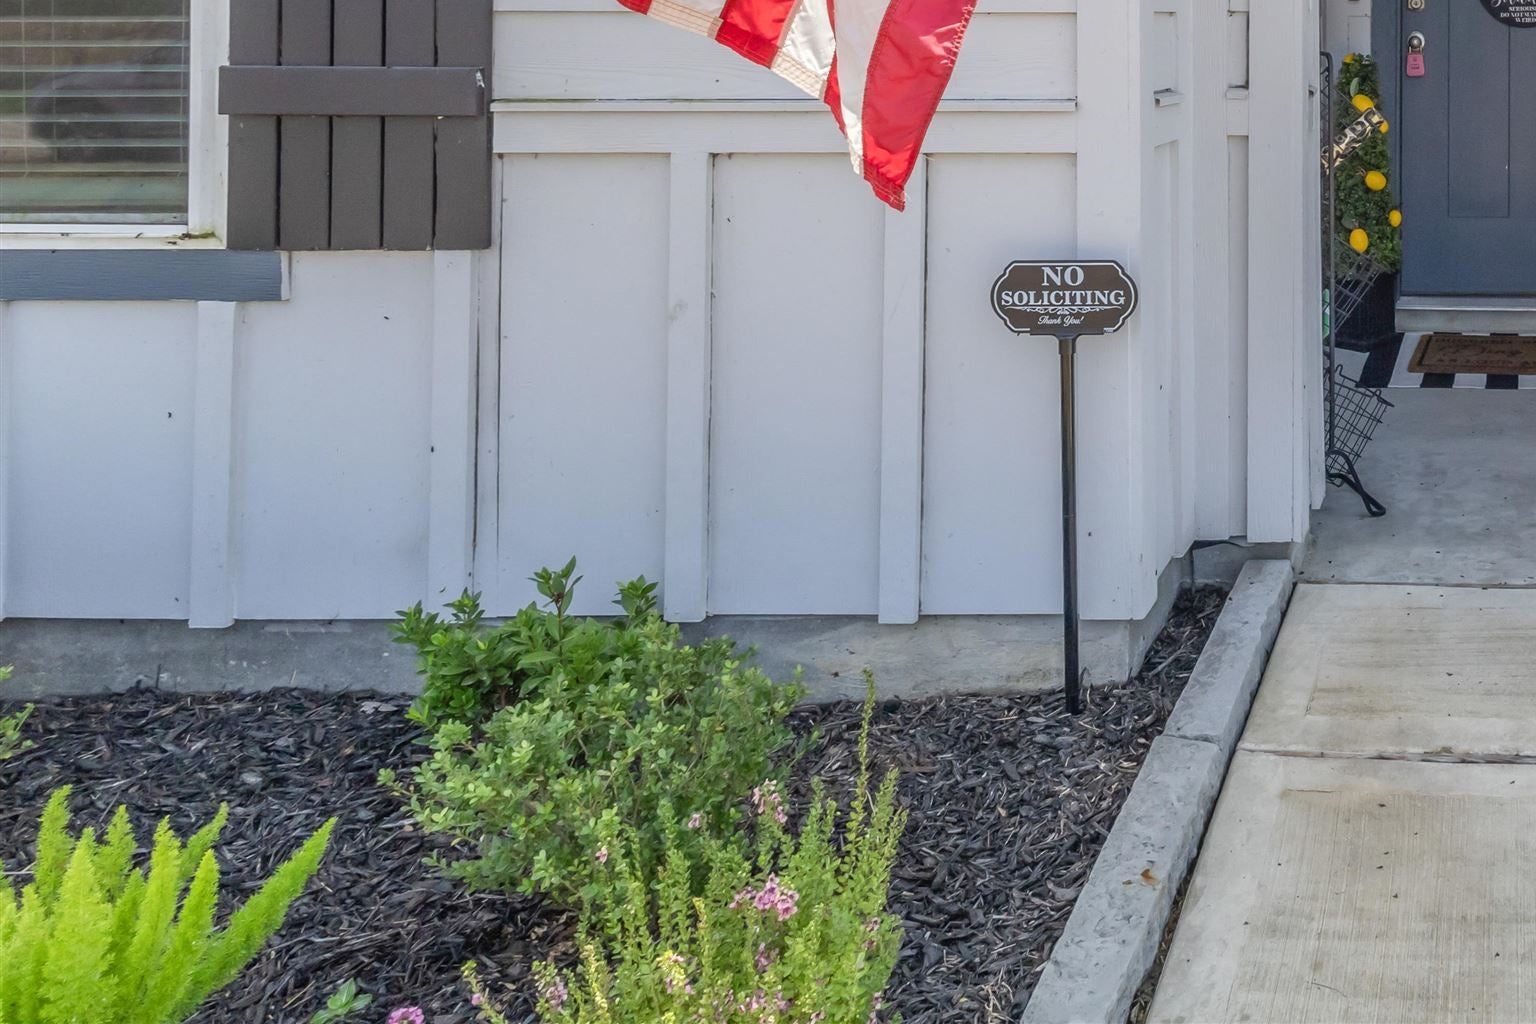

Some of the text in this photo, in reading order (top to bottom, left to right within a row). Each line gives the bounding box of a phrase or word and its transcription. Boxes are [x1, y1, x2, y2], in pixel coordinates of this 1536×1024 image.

[1041, 265, 1085, 286] NO
[1001, 290, 1126, 306] SOLICITING
[1037, 315, 1085, 326] Thank You!
